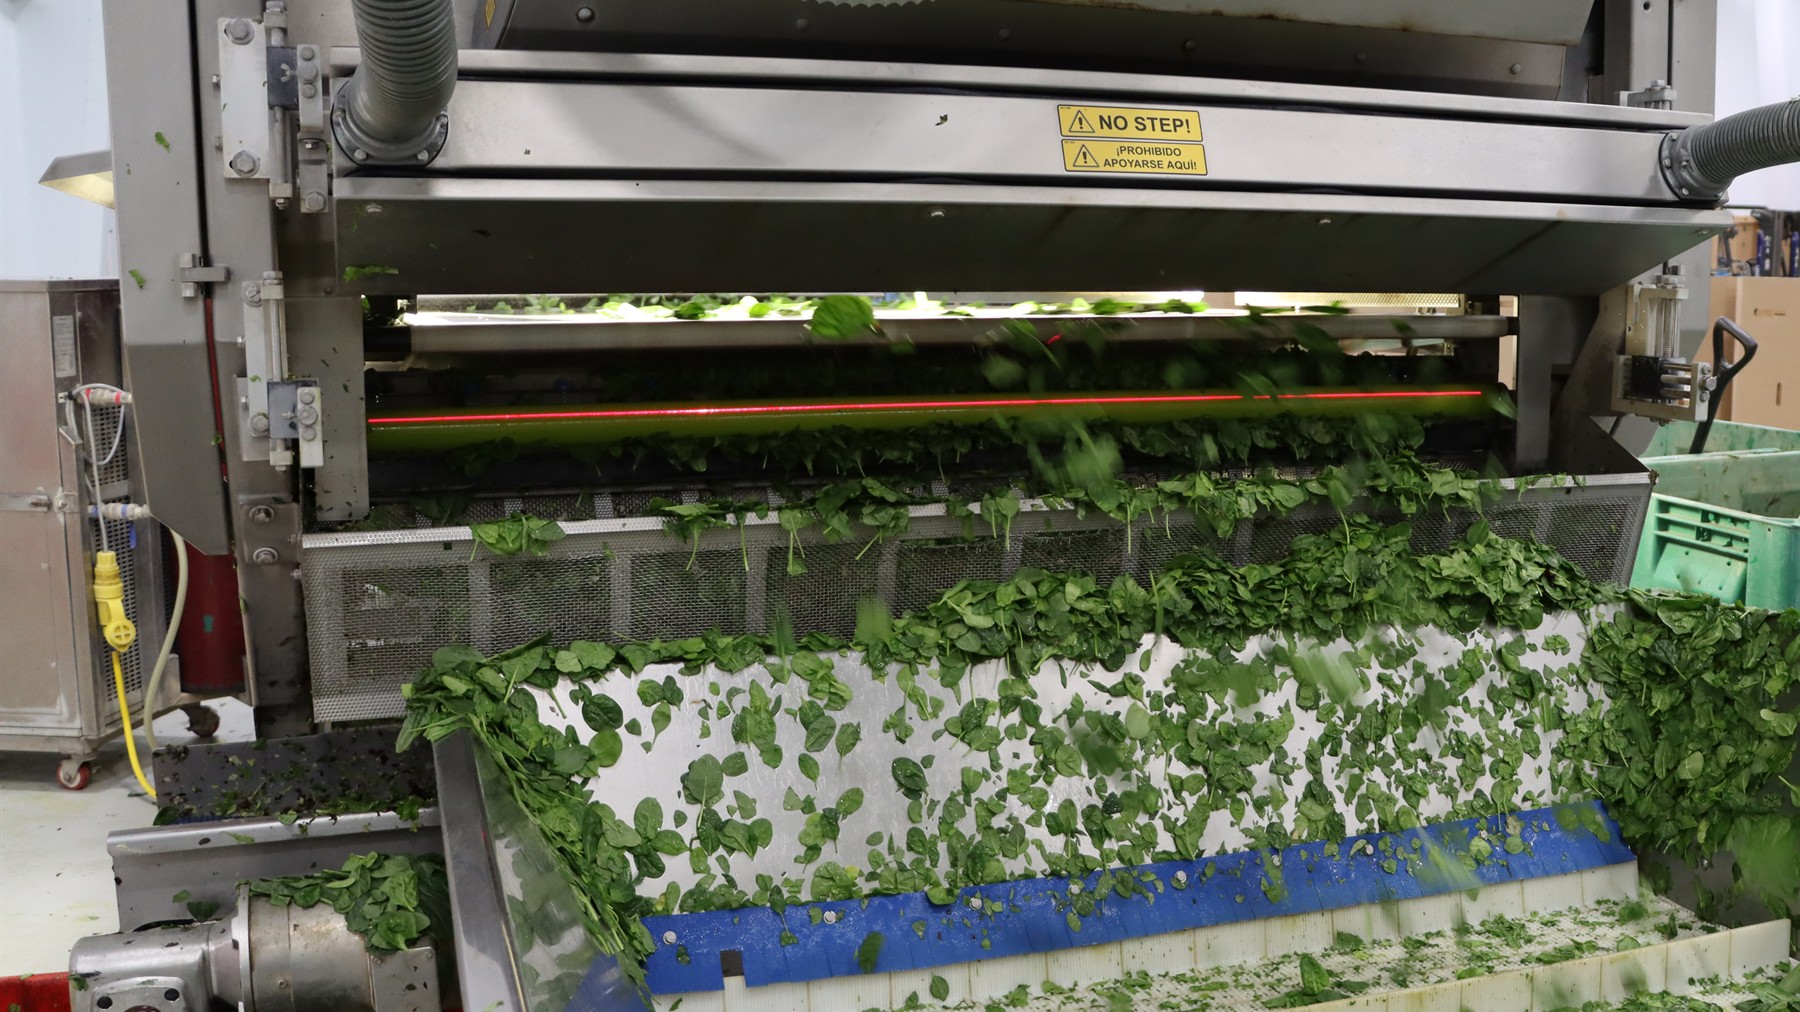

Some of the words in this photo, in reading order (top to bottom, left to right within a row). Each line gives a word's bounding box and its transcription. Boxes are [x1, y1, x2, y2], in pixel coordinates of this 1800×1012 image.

[1099, 115, 1128, 131] NO
[1135, 117, 1191, 133] STEP!
[1116, 146, 1181, 157] ¡PROHIBIDO
[1103, 159, 1164, 169] APOYARSE
[1167, 159, 1197, 170] AQUÍ!
